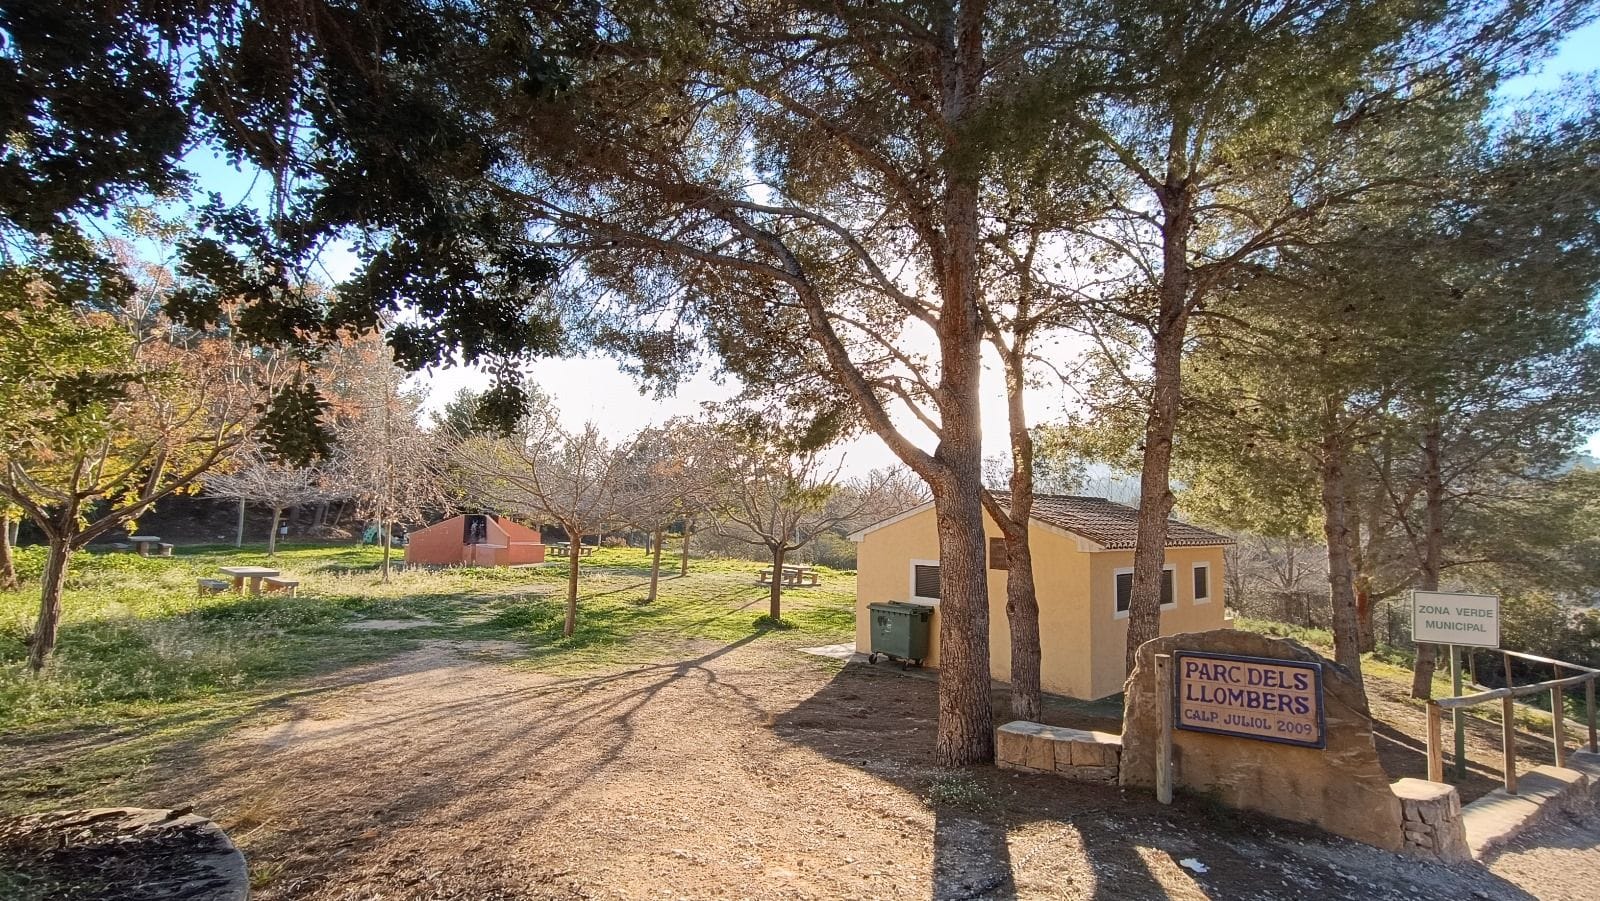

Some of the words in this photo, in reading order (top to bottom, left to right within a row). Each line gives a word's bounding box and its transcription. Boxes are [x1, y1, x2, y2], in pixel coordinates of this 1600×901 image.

[1419, 605, 1450, 616] ZONA
[1456, 608, 1493, 618] VERDE
[1426, 620, 1487, 632] MUNICIPAL
[1186, 662, 1241, 683] PARC
[1247, 668, 1308, 690] DELS
[1186, 684, 1309, 715] LLOMBERS
[1224, 715, 1271, 729] JULIOL
[1277, 720, 1312, 734] 2009
